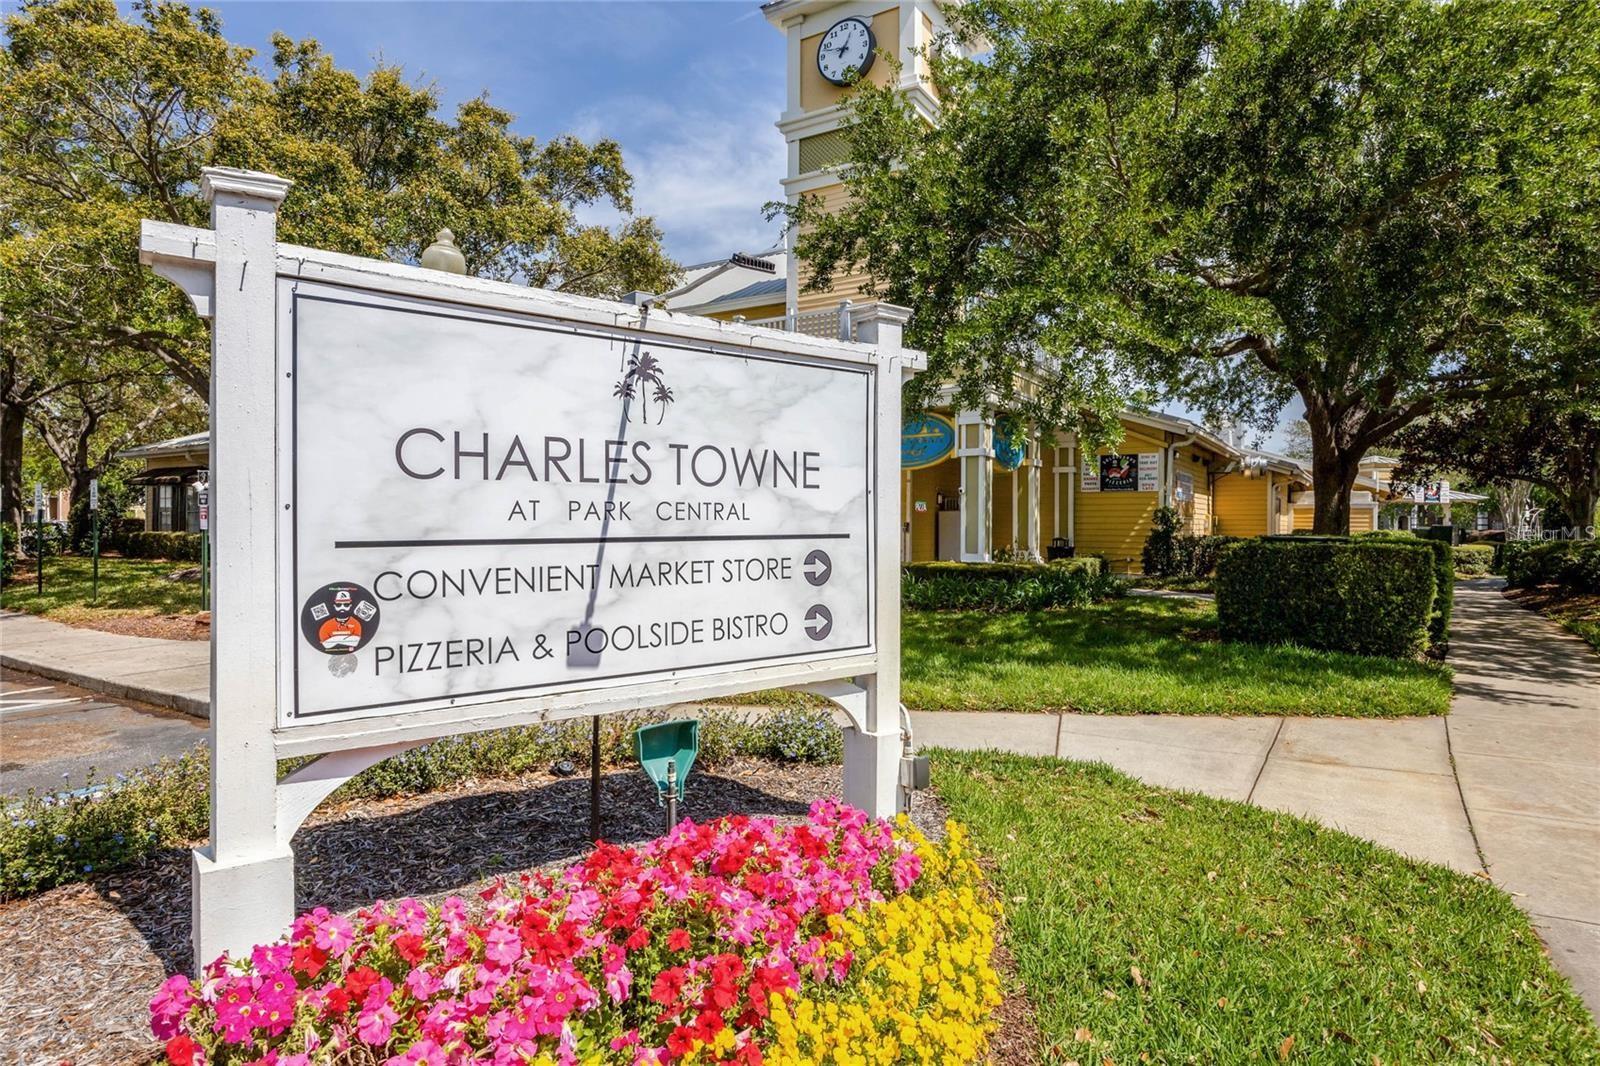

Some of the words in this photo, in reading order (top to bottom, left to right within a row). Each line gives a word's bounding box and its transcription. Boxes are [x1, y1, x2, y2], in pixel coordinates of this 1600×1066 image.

[840, 23, 849, 31] 12
[395, 427, 651, 485] CHARLES
[668, 443, 820, 489] TOWNE
[508, 500, 540, 521] AT
[569, 500, 631, 521] PARK
[656, 501, 750, 521] CENTRAL
[373, 564, 599, 600] CONVENIENT
[609, 560, 714, 588] MARKET
[722, 557, 792, 583] STORE
[375, 636, 519, 676] PIZZERIA
[532, 633, 554, 659] &
[566, 619, 703, 656] POOLSIDE
[713, 612, 788, 641] BISTRO
